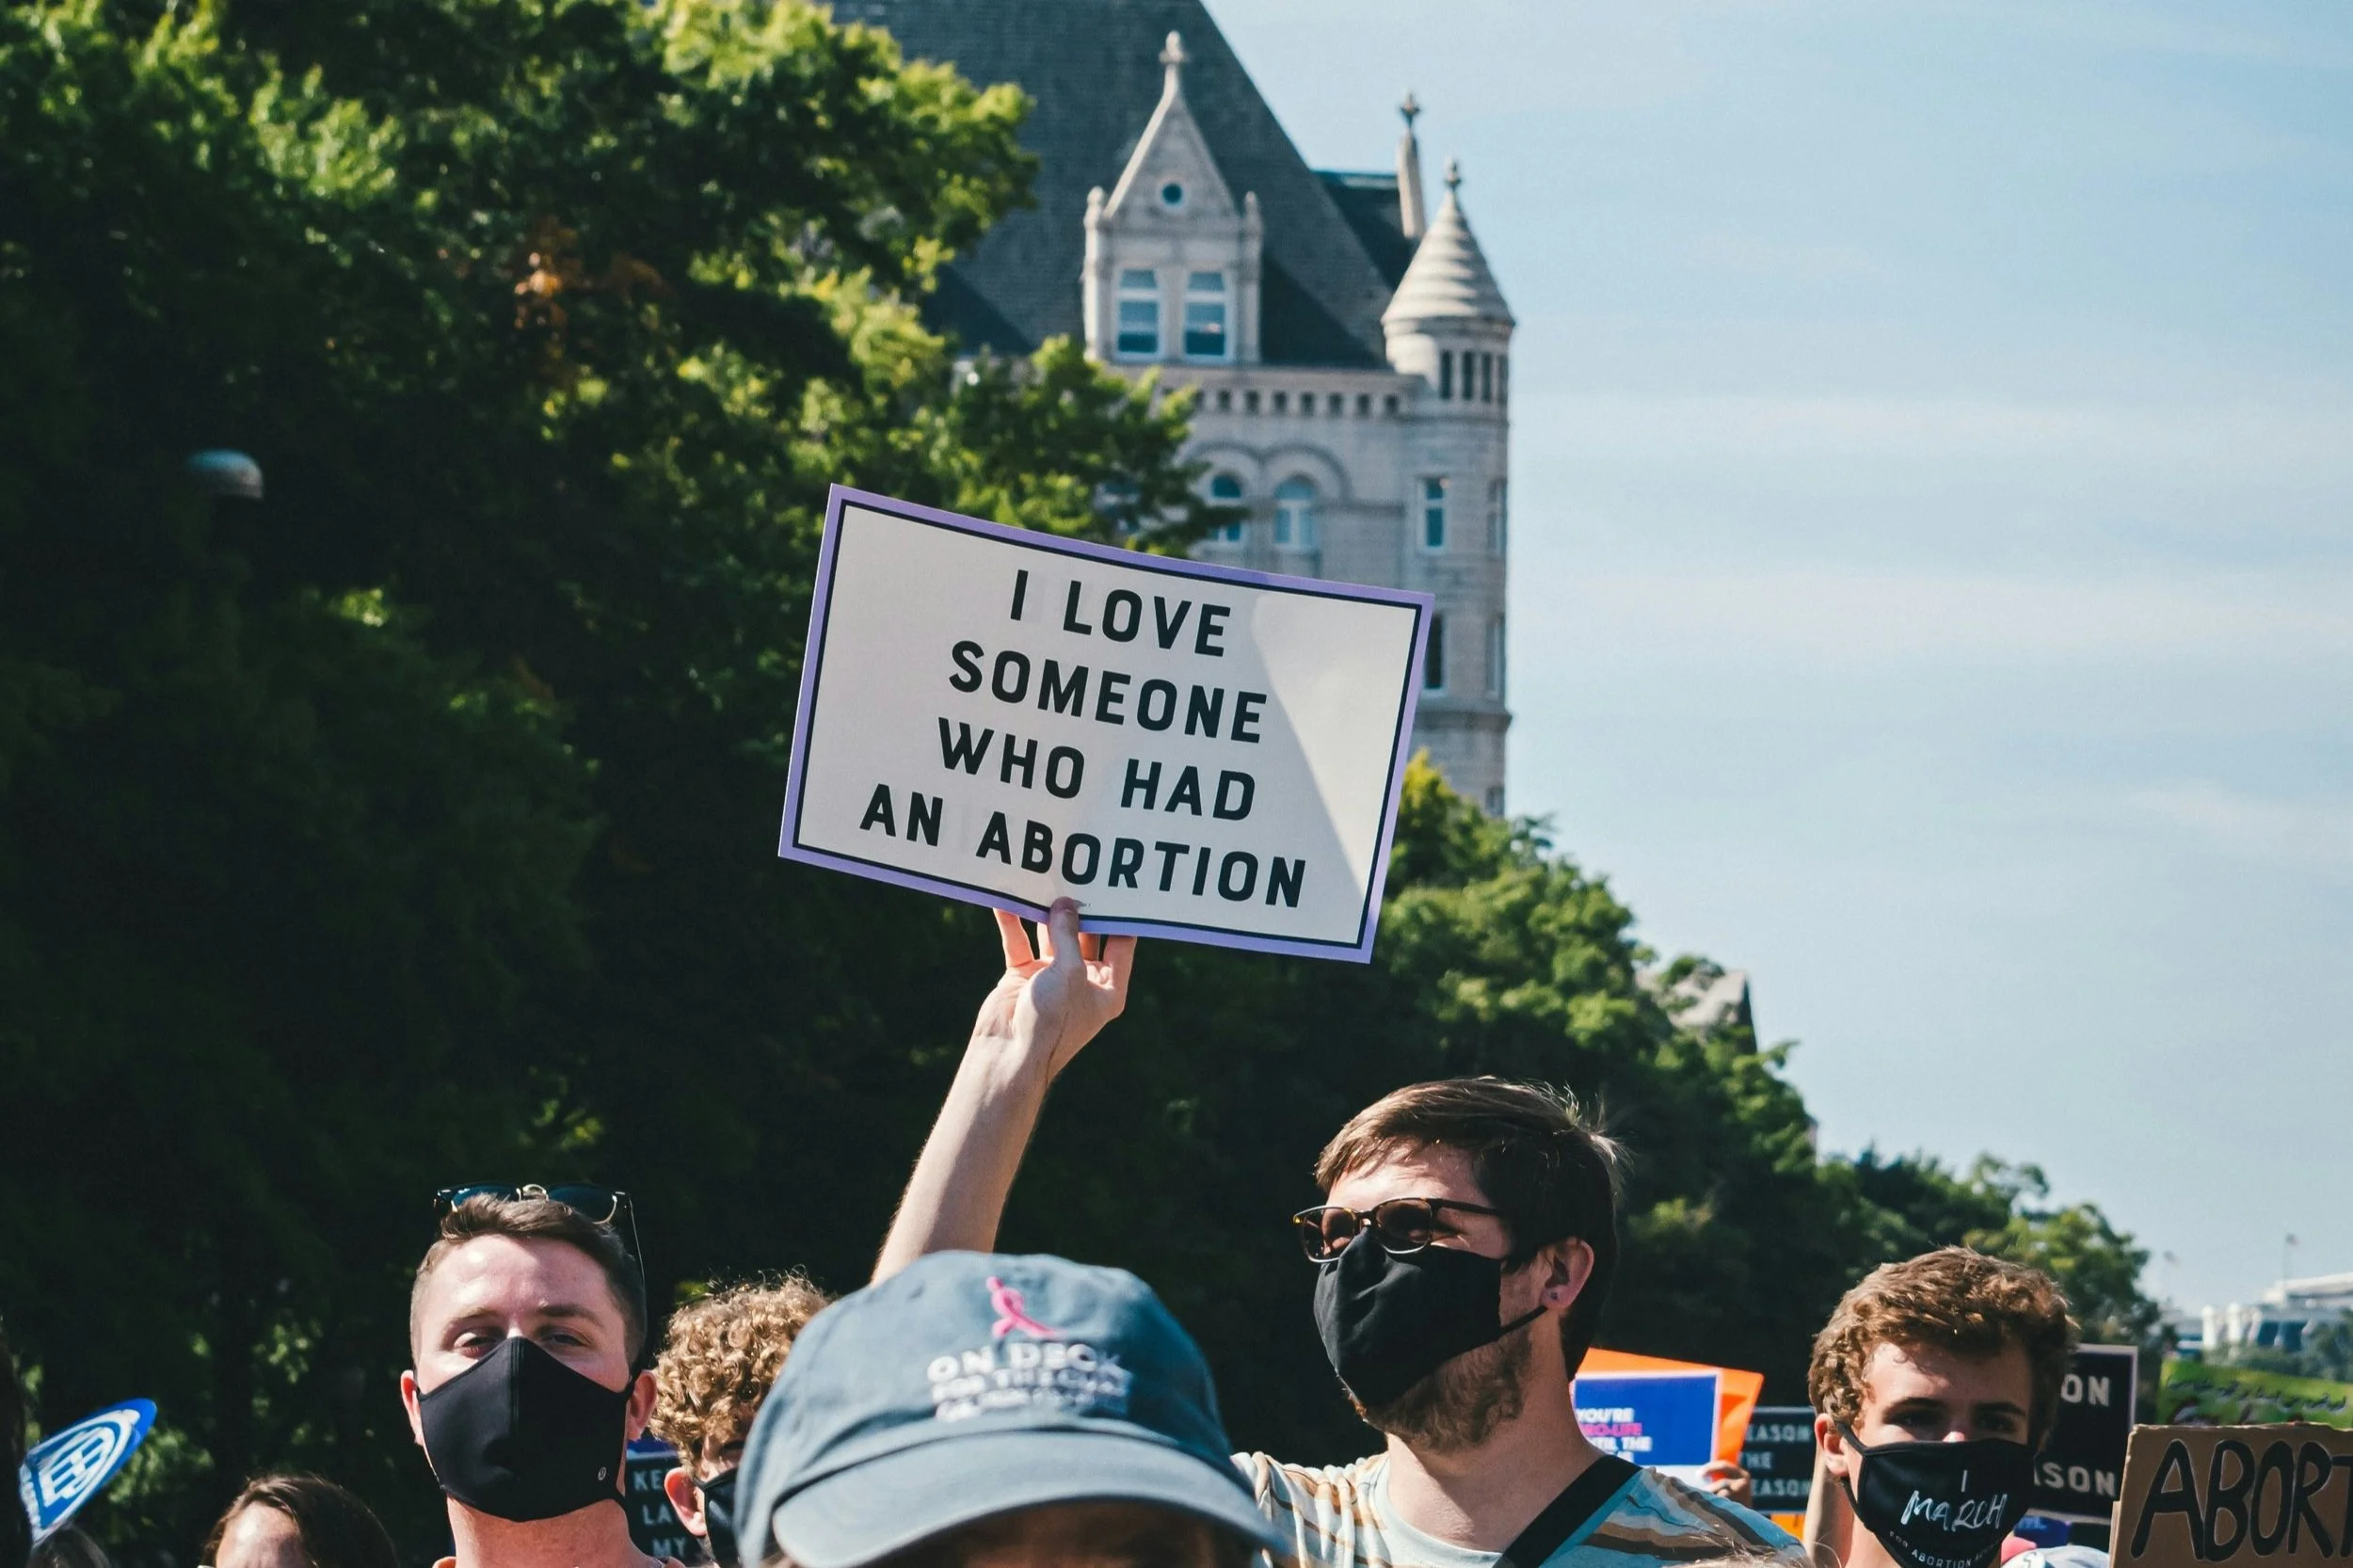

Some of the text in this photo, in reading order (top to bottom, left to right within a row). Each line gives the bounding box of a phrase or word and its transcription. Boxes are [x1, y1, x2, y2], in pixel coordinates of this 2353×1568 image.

[1010, 569, 1231, 658] I LOVE
[949, 640, 1268, 744] SOMEONE
[937, 716, 1256, 821] WHO HAD
[859, 783, 1306, 908] AN ABORTION
[927, 1346, 995, 1383] ON
[2060, 1373, 2111, 1407] ON
[1580, 1422, 1642, 1437] RO-LIFE
[1746, 1424, 1812, 1442] EASON
[1961, 1469, 1968, 1493] I
[1900, 1490, 2008, 1532] MARCH
[651, 1537, 686, 1559] MY
[1911, 1548, 1973, 1568] ABORTION
